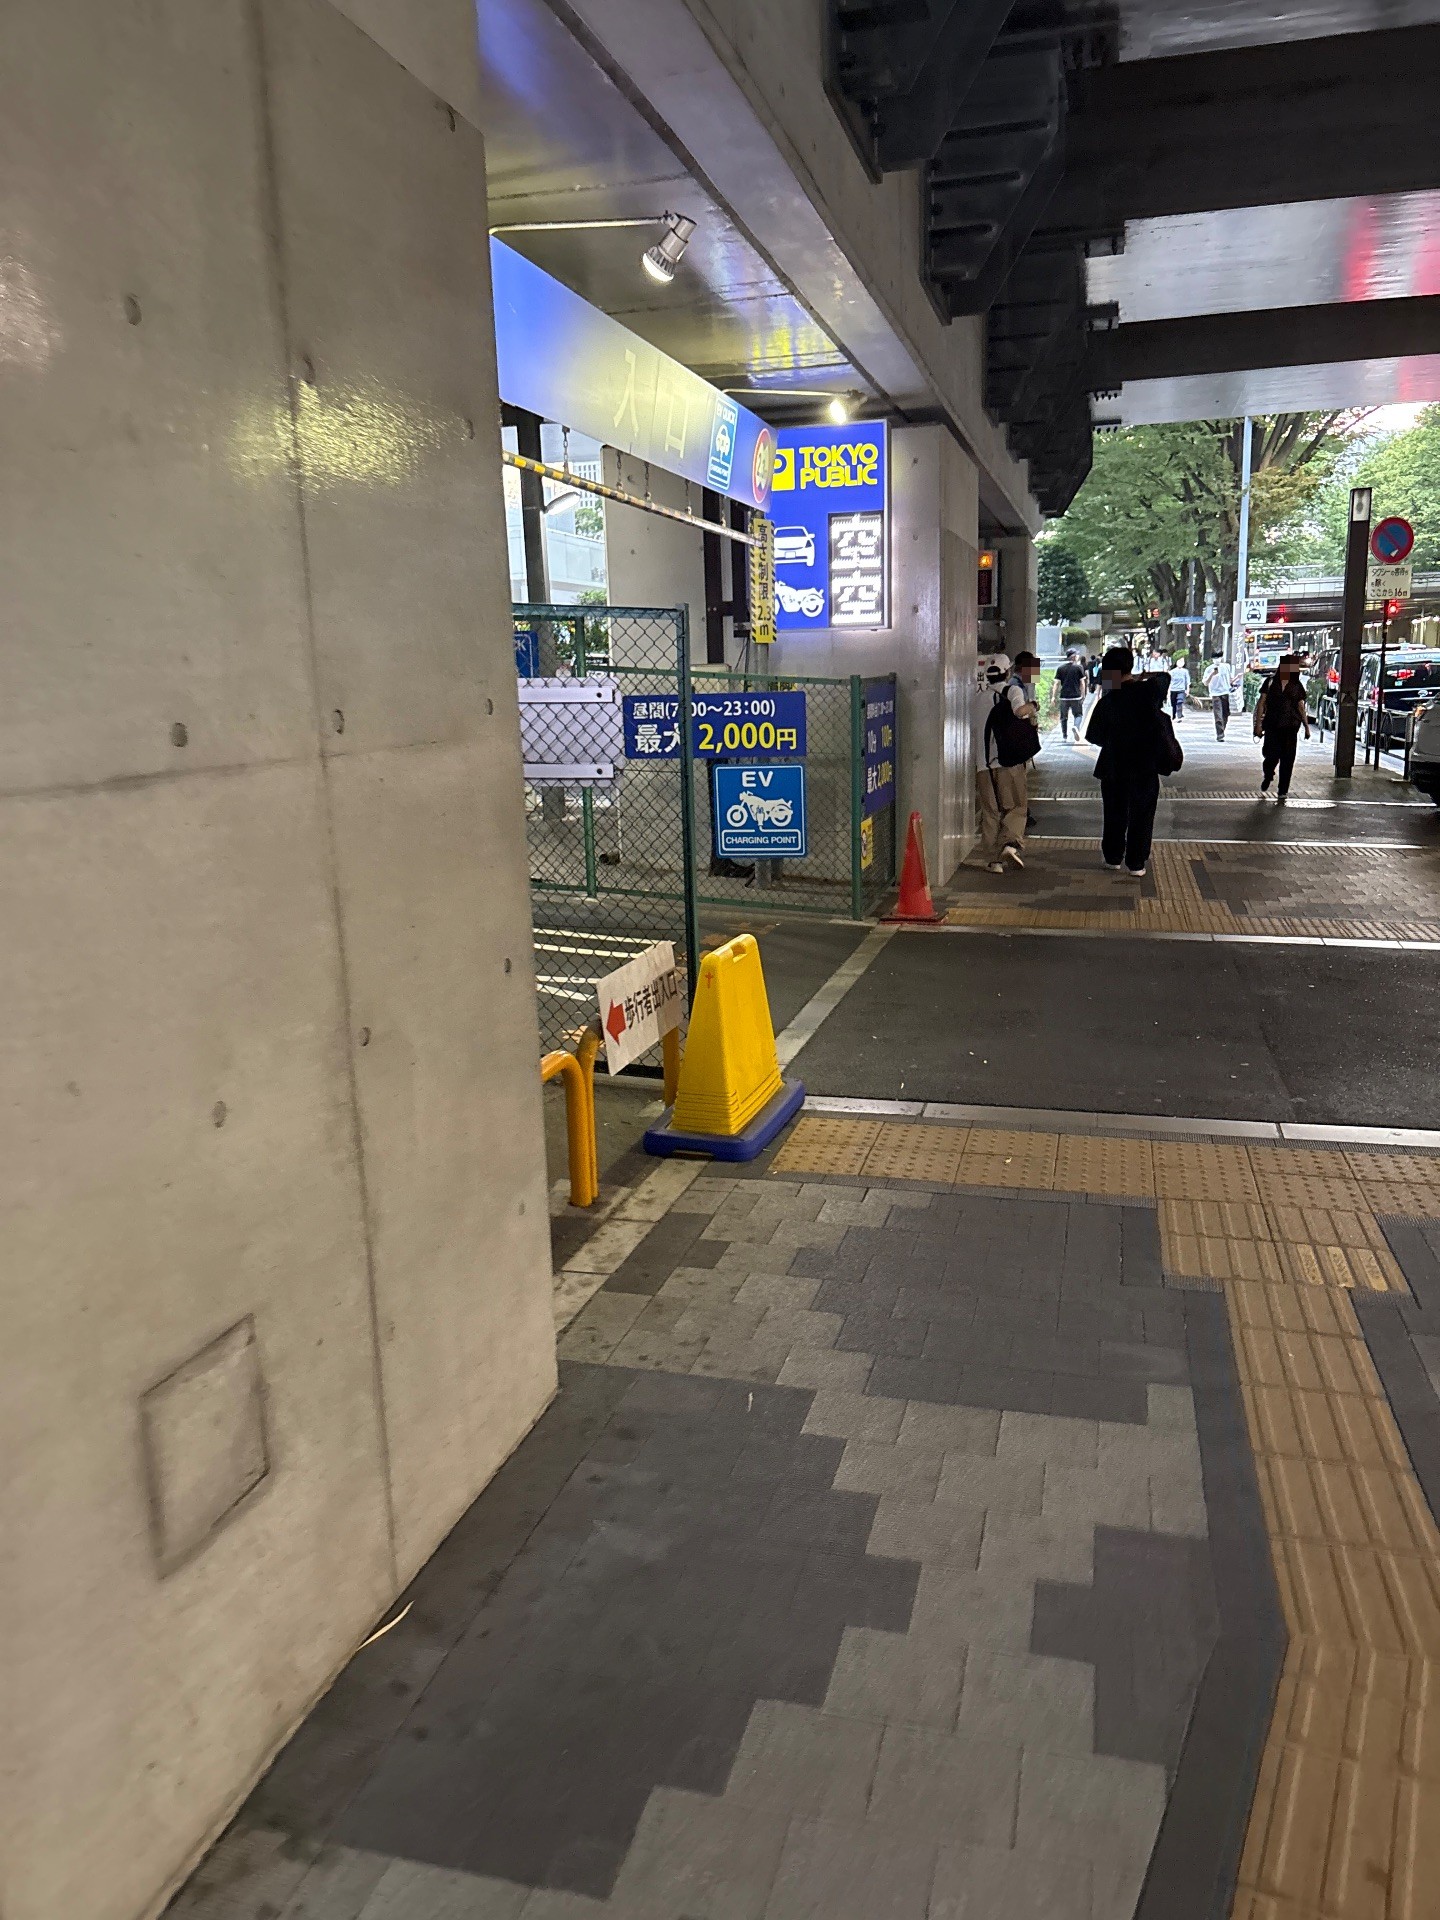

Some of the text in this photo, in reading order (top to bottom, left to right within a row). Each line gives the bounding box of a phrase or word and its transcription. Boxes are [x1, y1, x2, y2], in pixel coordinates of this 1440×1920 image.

[613, 348, 690, 459] 入口
[799, 443, 878, 468] TOKYO
[800, 463, 877, 489] PUBLIC
[698, 722, 797, 753] 2,000円
[741, 770, 774, 788] EV
[725, 835, 798, 845] CHARGING POINT
[625, 970, 678, 1030] 歩行者出入口
